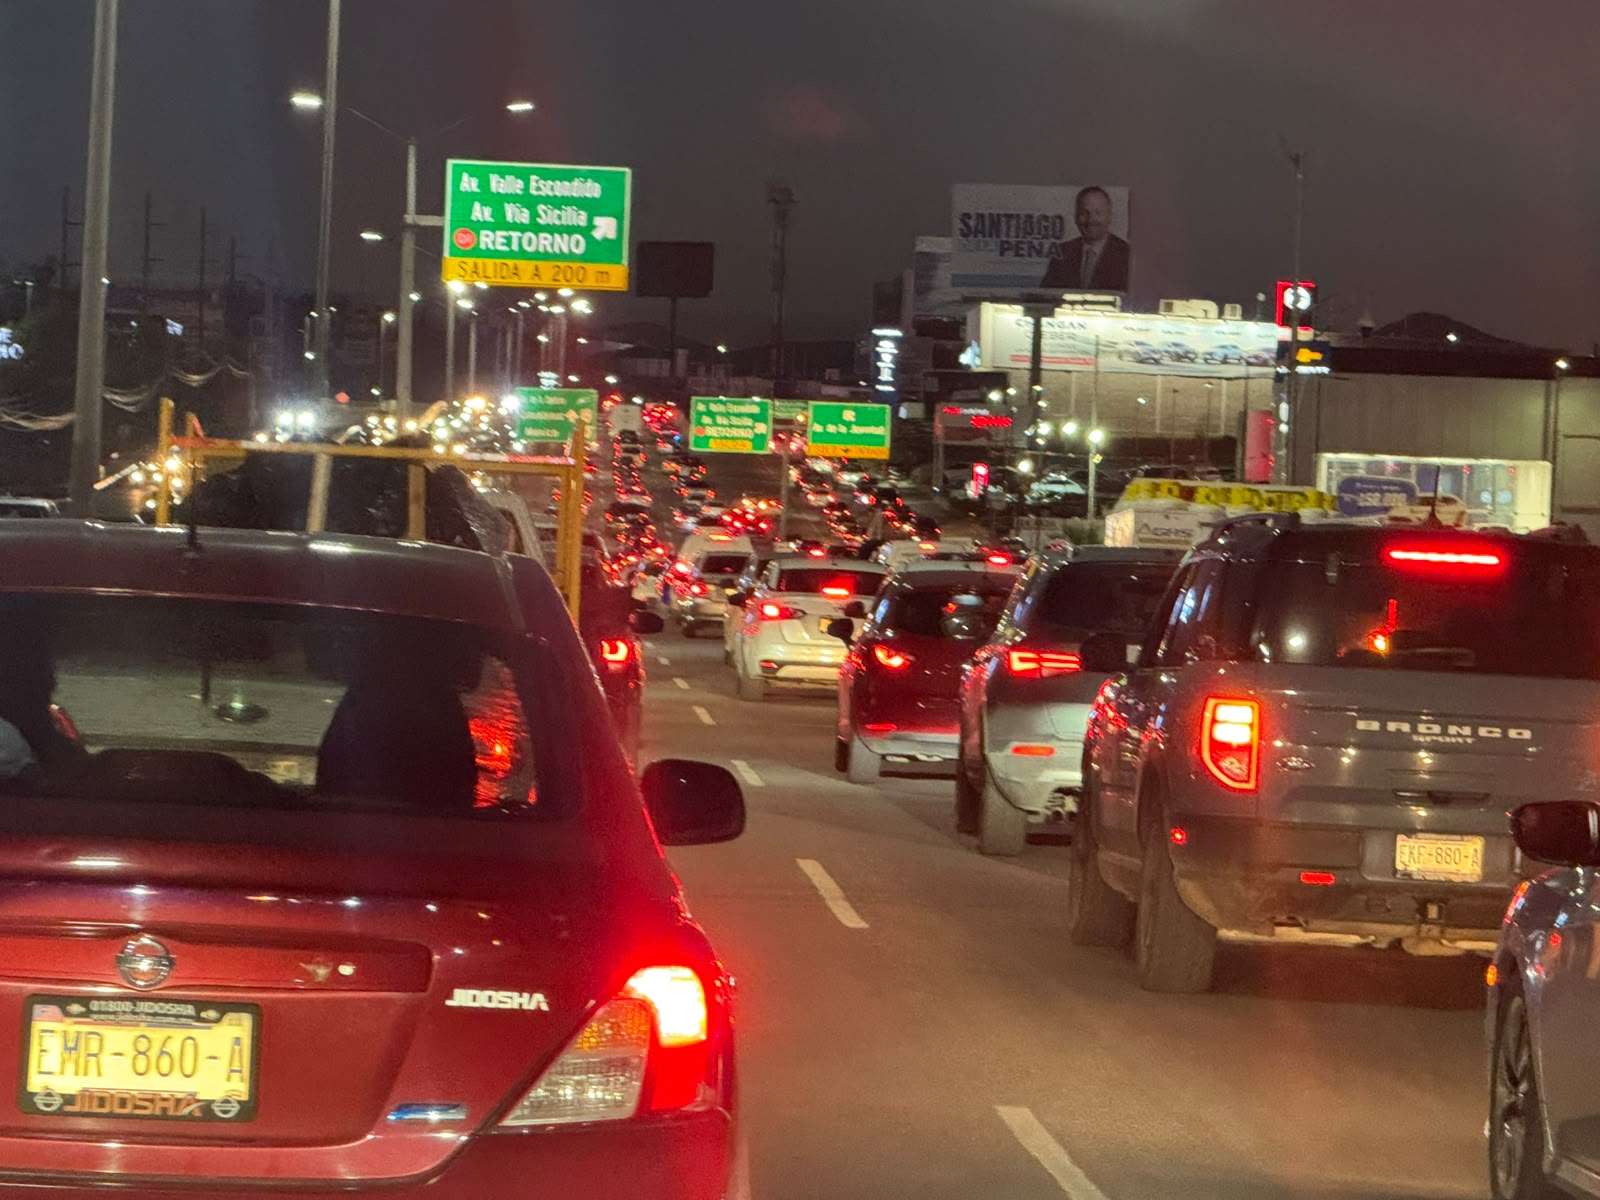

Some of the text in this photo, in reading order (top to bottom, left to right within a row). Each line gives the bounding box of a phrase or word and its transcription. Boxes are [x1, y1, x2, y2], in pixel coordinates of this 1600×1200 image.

[489, 173, 524, 195] Valle
[529, 175, 602, 198] Escondido
[536, 204, 588, 227] Sicilia
[959, 212, 1064, 240] SANTIAGO
[479, 230, 586, 255] RETORNO
[458, 260, 610, 283] SALIDA A 200 m
[1356, 719, 1532, 740] BRONCO
[1412, 735, 1477, 744] SPORT
[445, 988, 549, 1011] JIDOSHA
[37, 1029, 245, 1083] EMR-860-A
[63, 1090, 204, 1117] JIDOSHA
